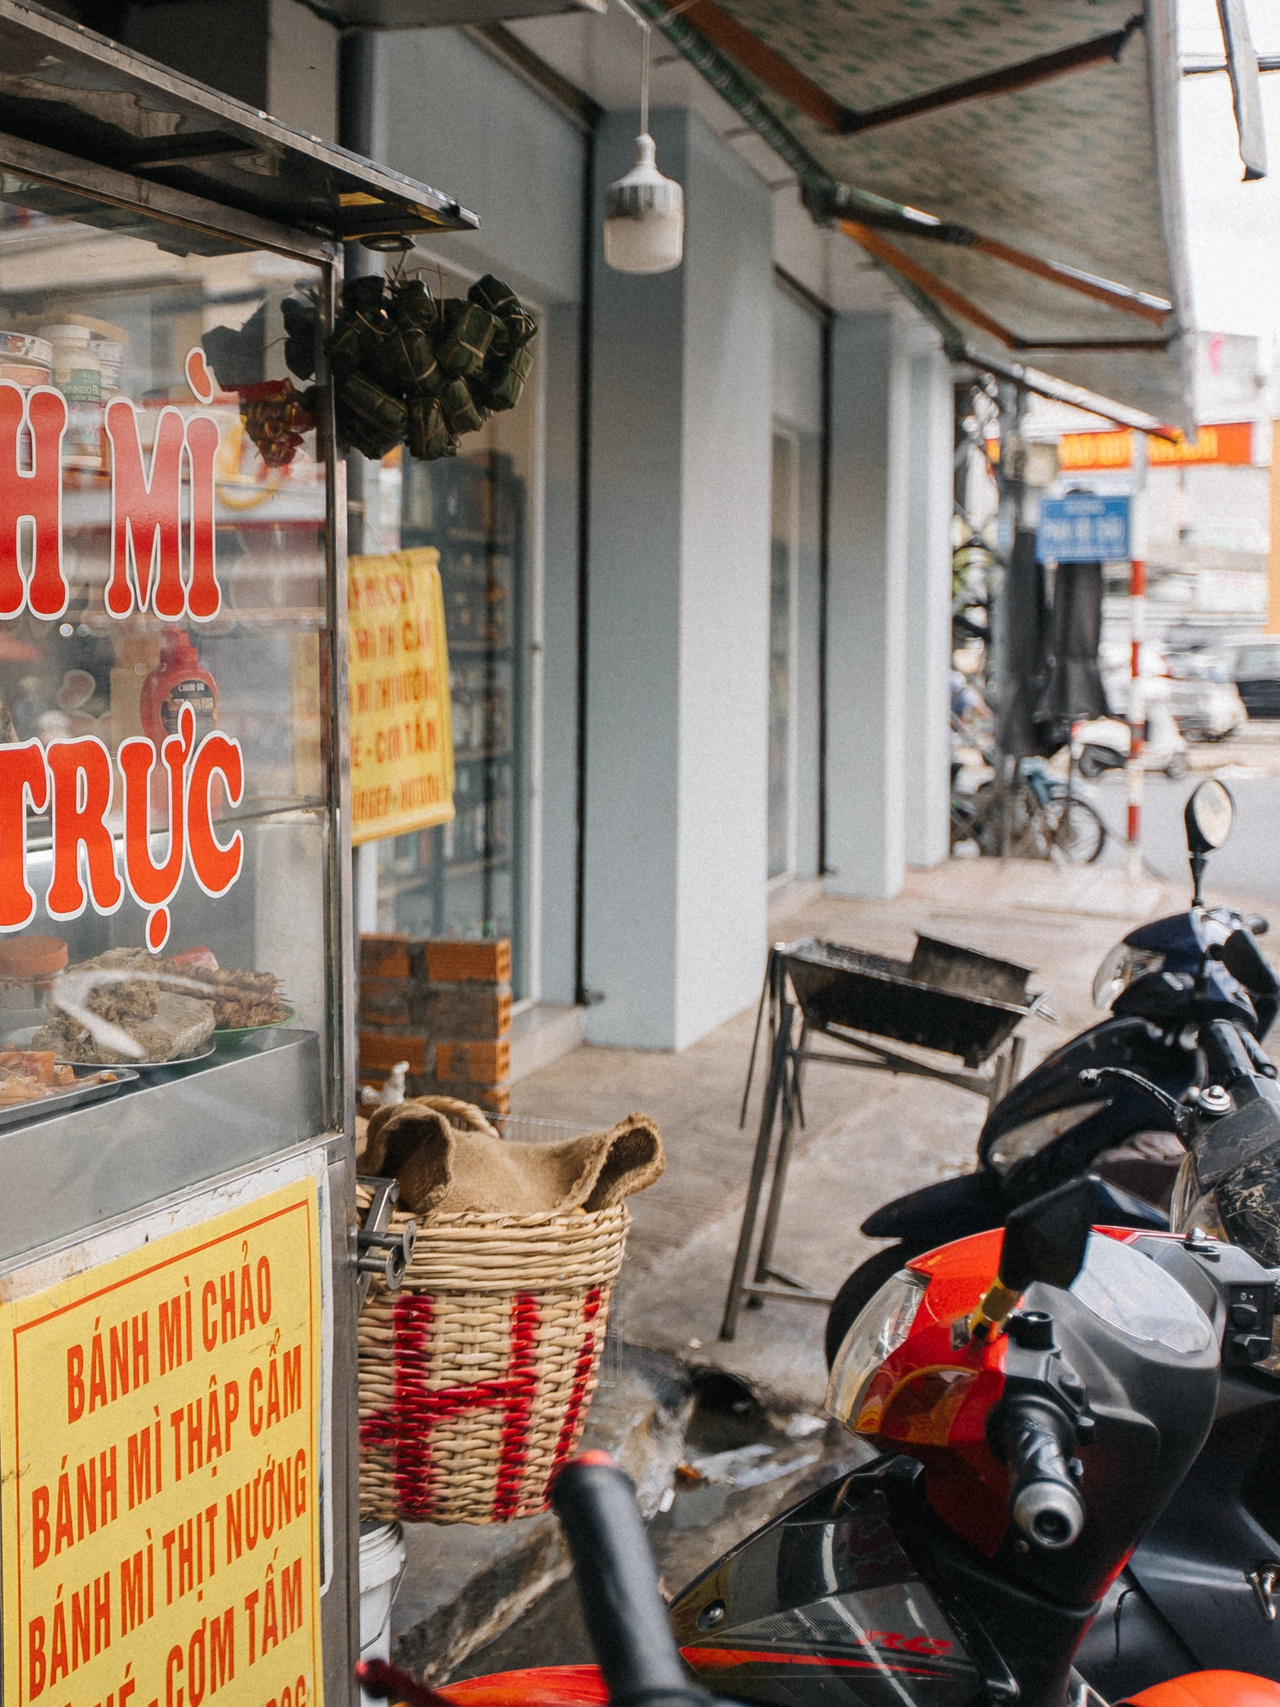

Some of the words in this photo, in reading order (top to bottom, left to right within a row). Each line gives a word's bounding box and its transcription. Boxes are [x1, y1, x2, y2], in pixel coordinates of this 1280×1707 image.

[105, 346, 221, 622] MÌ
[178, 682, 205, 692] CHIN-SU
[67, 1312, 149, 1424] BÁNH
[158, 1275, 193, 1376] MÌ
[202, 1240, 272, 1352] CHẢO
[32, 1445, 118, 1569] BÁNH
[127, 1405, 162, 1511] MÌ
[171, 1375, 239, 1481] THẬP
[249, 1328, 302, 1438] CẨM
[29, 1571, 112, 1702] BÁNH
[121, 1528, 155, 1637] MÌ
[162, 1503, 218, 1603] THỊT
[226, 1449, 306, 1565] NƯỚNG
[166, 1606, 235, 1707] CƠM
[244, 1548, 303, 1667] TẤM
